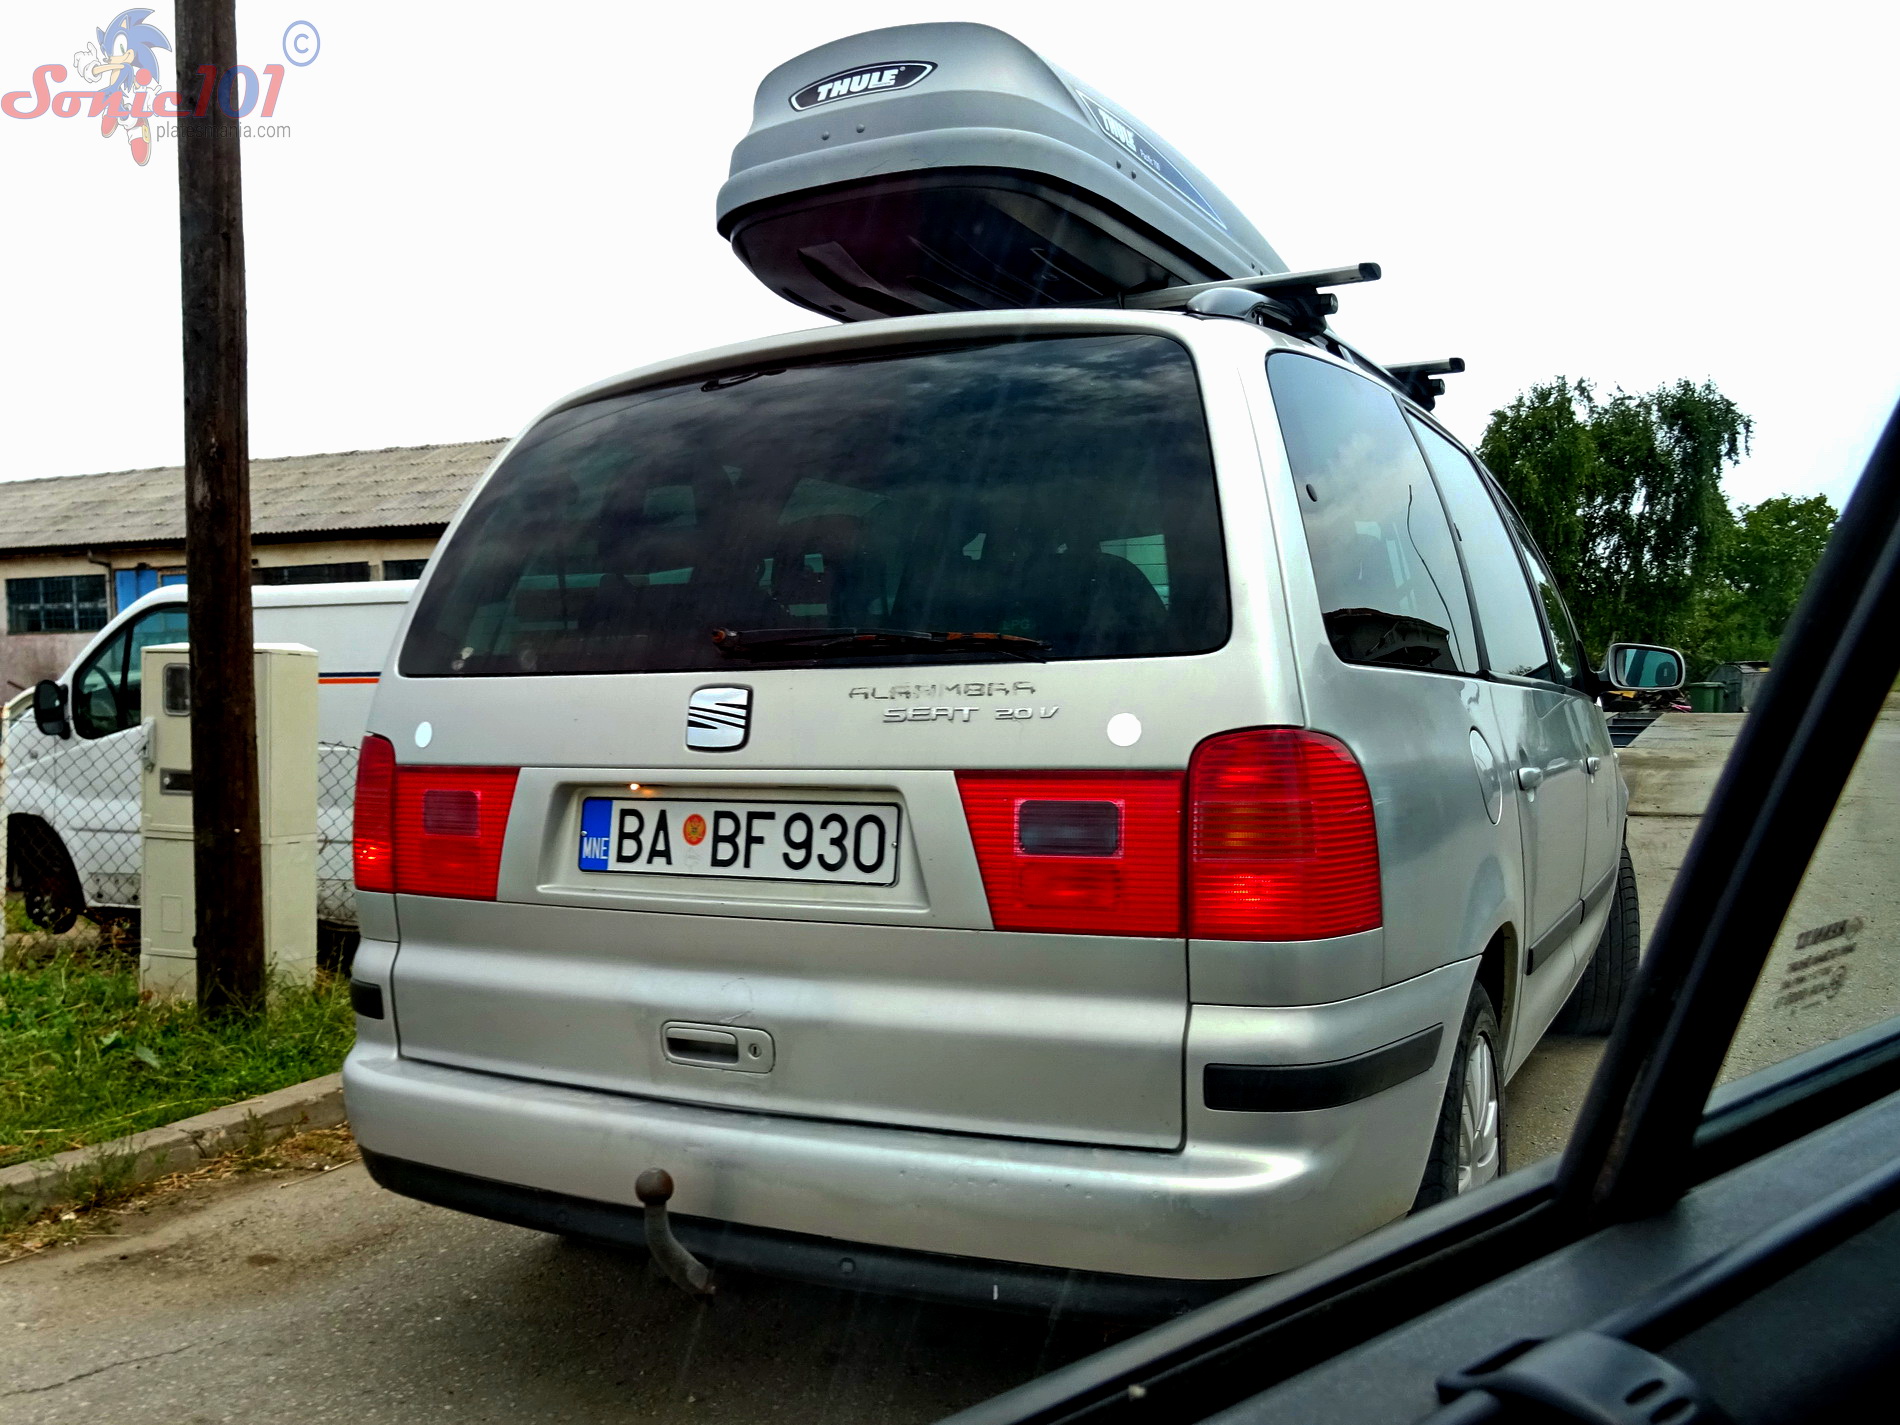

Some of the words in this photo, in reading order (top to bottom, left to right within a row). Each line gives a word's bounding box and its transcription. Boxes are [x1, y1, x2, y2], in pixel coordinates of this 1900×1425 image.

[816, 69, 899, 102] THULE
[1098, 108, 1137, 153] THULE
[883, 706, 980, 723] SEAT
[582, 837, 610, 860] MNE
[616, 808, 673, 865] BA
